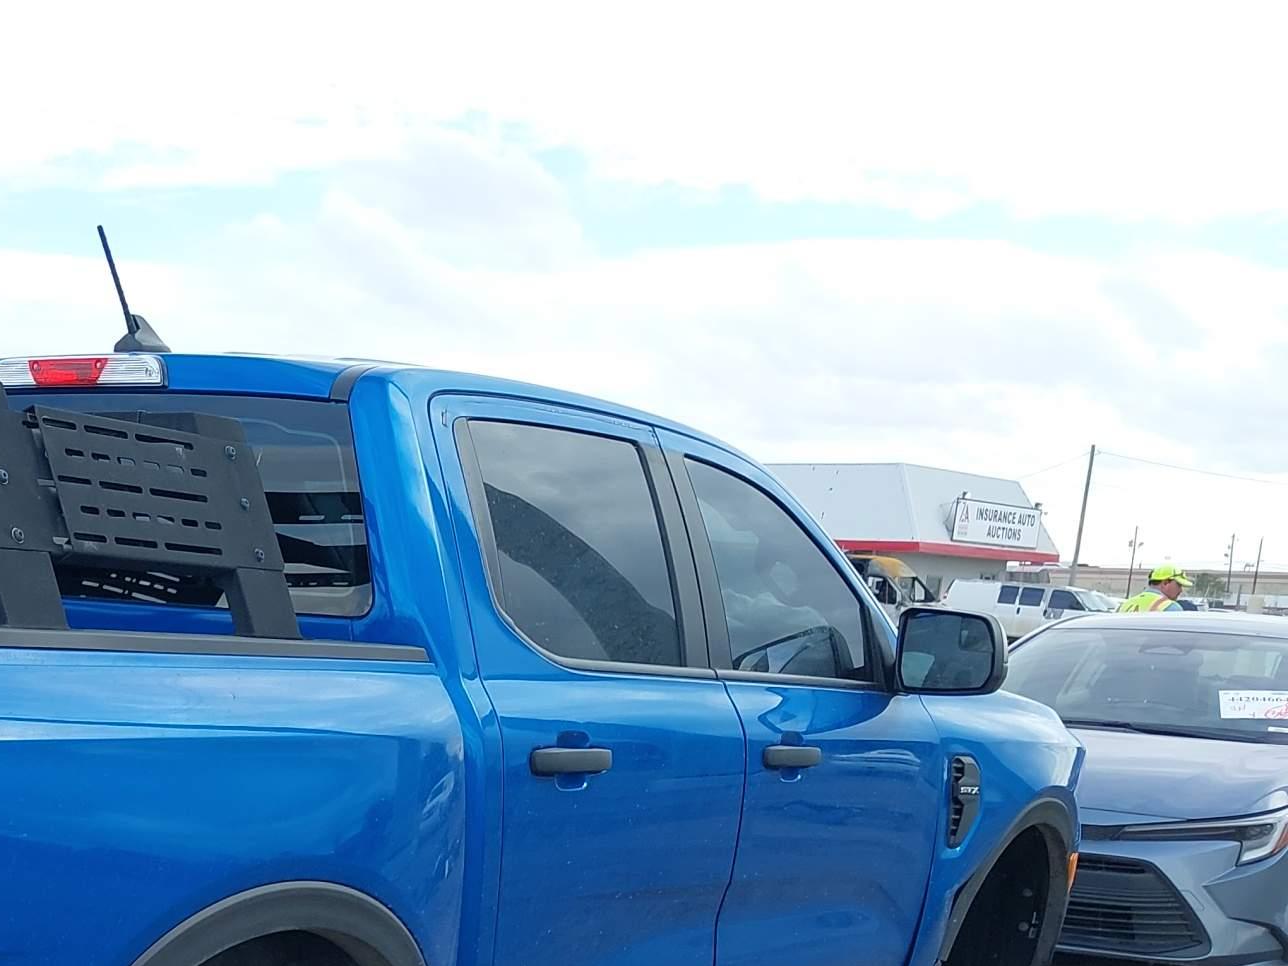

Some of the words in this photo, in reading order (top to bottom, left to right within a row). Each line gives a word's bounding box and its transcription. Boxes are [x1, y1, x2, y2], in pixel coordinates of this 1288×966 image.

[975, 508, 1016, 525] INSURANCE
[1017, 512, 1036, 528] AUTO
[986, 525, 1022, 541] AUCTIONS
